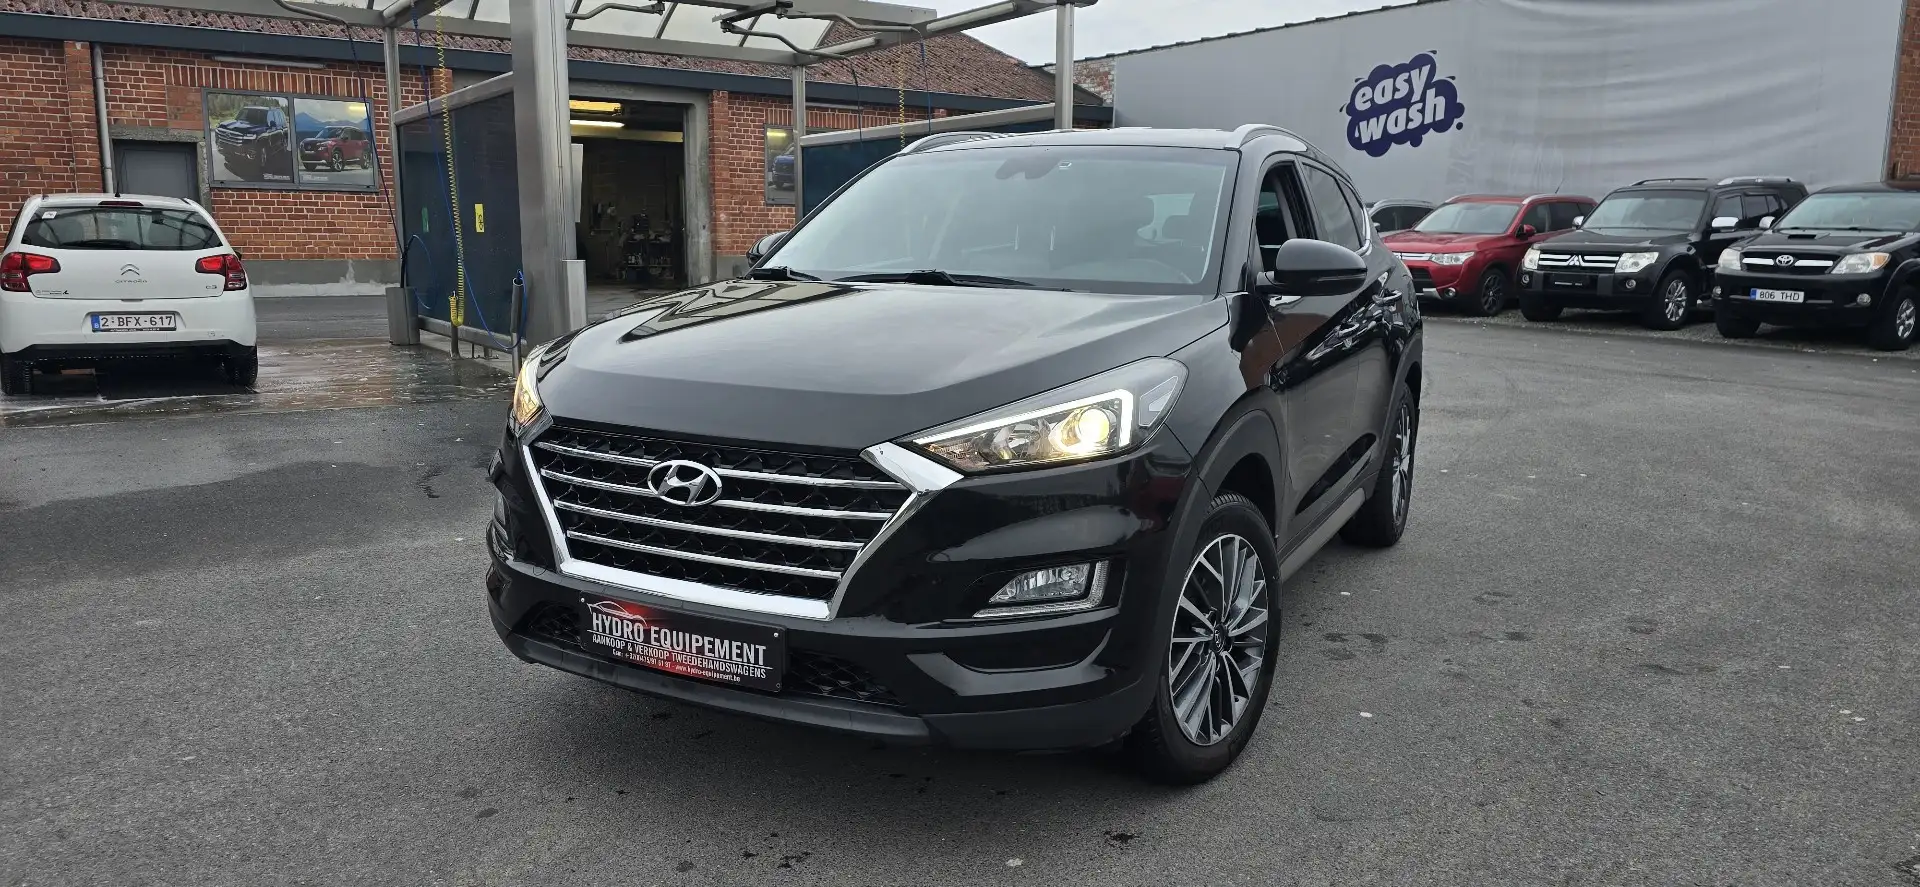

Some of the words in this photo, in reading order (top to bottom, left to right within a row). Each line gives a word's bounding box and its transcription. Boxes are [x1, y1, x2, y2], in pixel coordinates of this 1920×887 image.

[1354, 64, 1431, 111] easy
[1358, 88, 1445, 144] wash
[1759, 291, 1775, 299] 806
[1780, 292, 1800, 300] THD
[592, 612, 644, 642] HYDRO
[651, 626, 767, 665] EQUIPEMENT
[592, 634, 626, 650] AANKOOP
[627, 643, 633, 652] &
[634, 644, 670, 659] VERKOOP
[671, 652, 767, 679] TWEEDEHANDSWAGENS
